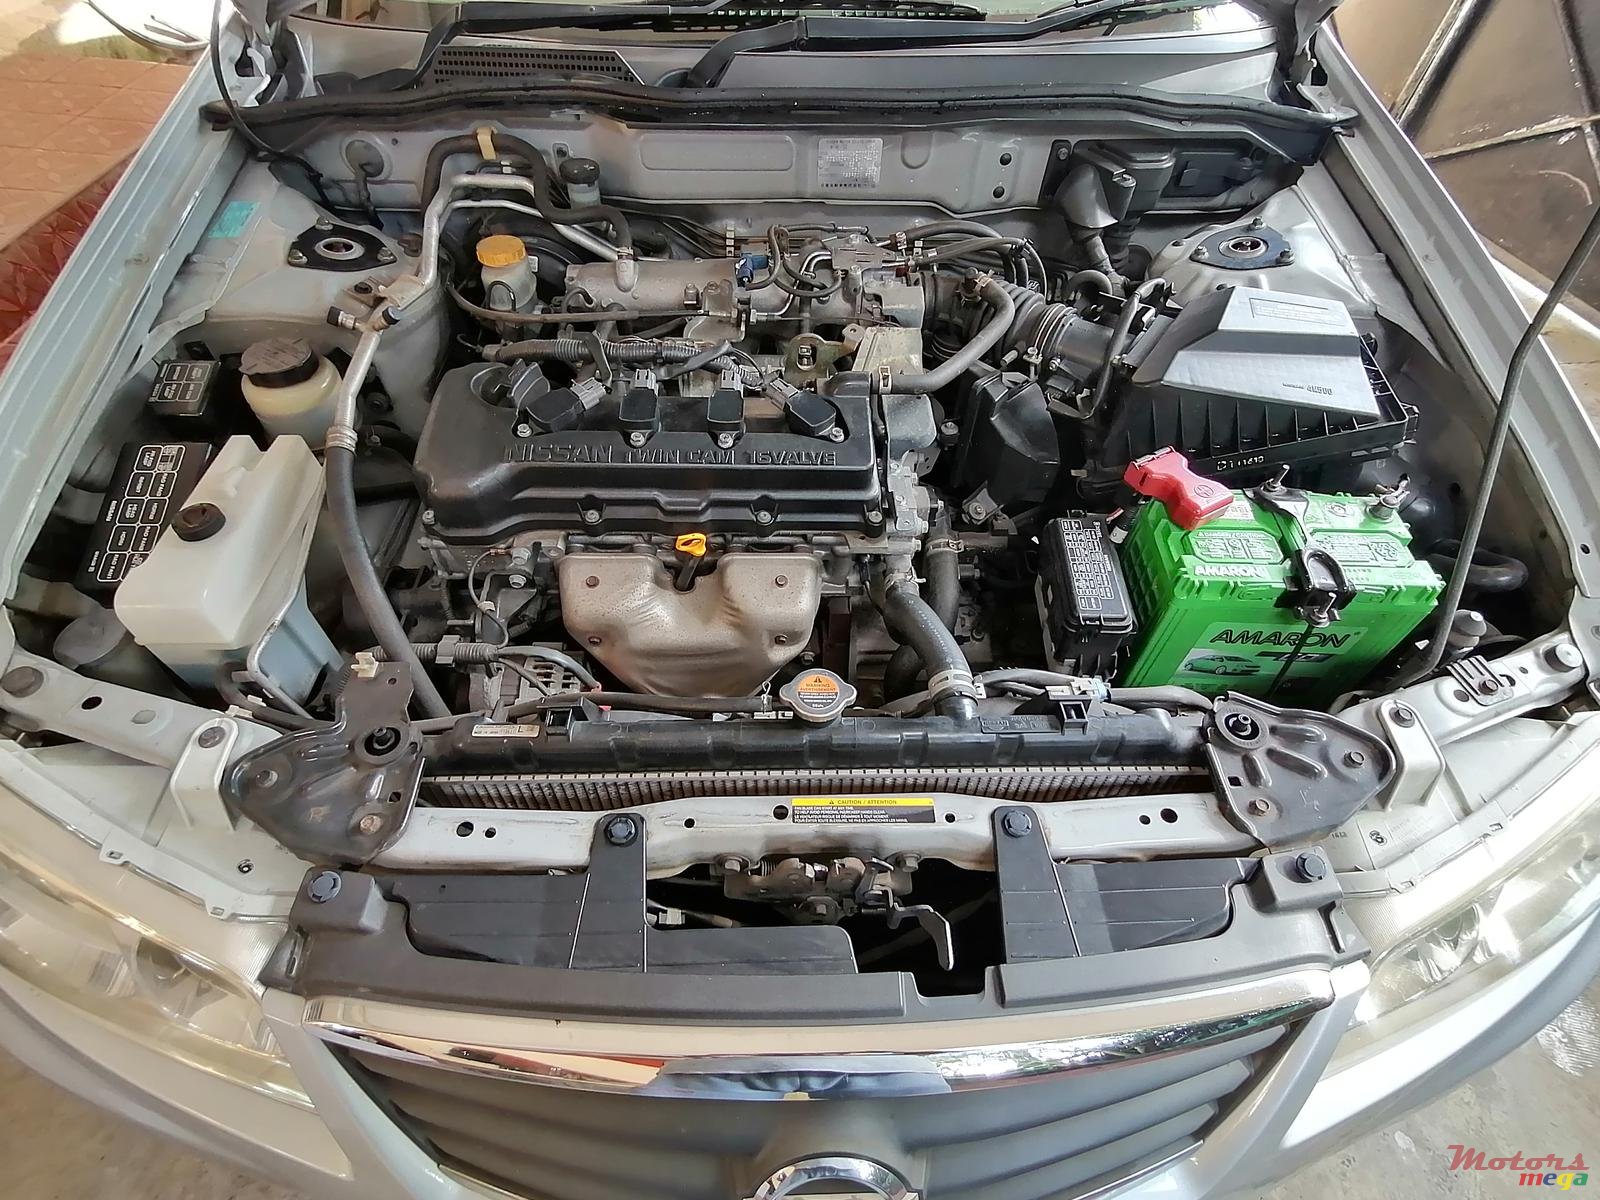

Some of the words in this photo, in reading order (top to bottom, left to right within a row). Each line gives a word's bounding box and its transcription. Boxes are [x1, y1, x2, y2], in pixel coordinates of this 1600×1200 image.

[505, 444, 613, 463] NISSAN
[625, 449, 681, 464] TWIN
[687, 449, 736, 465] CAM
[1195, 565, 1265, 578] AMARON
[1209, 629, 1351, 649] AMARON
